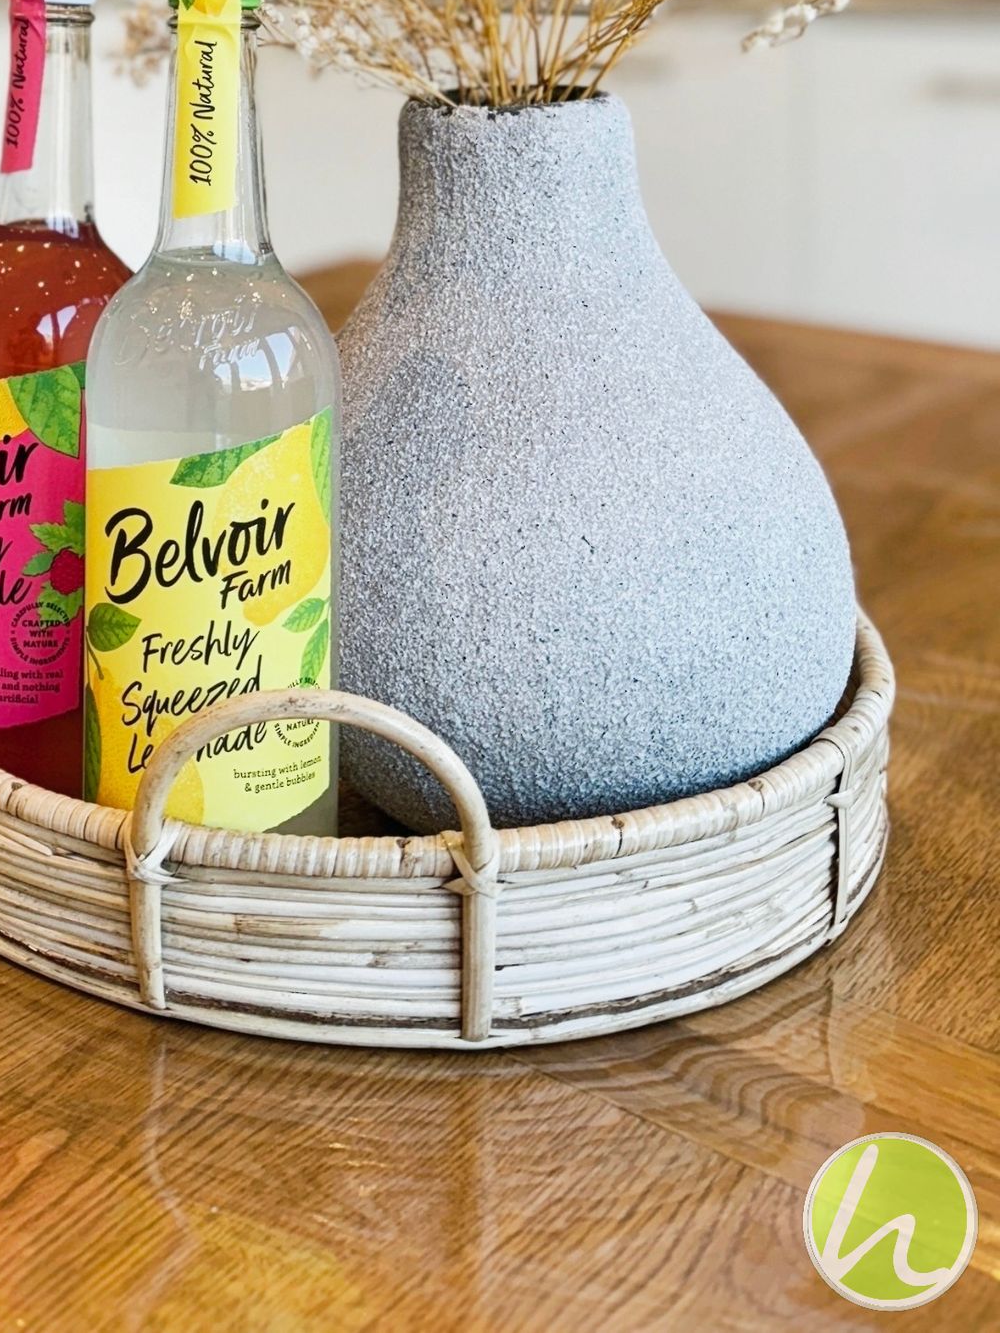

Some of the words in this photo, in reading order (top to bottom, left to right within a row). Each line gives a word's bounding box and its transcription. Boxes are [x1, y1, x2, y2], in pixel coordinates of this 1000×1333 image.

[12, 15, 30, 89] Natural
[189, 40, 218, 120] Natural
[4, 92, 25, 148] 100%
[189, 123, 217, 186] 100%
[105, 498, 295, 604] Belvoir
[220, 560, 291, 609] Farm
[22, 619, 61, 627] CRAFTED
[23, 640, 58, 648] NATURE
[29, 629, 54, 637] WITH
[142, 620, 260, 673] Freshly
[1, 681, 20, 691] and
[22, 681, 60, 693] nothing
[21, 669, 43, 679] with
[45, 669, 64, 679] real
[121, 654, 262, 737] Squeezed
[128, 721, 268, 774] Lenade
[274, 722, 292, 746] SIMPLE
[233, 769, 277, 779] bursting
[279, 762, 299, 774] with
[300, 755, 322, 769] lemon
[244, 783, 252, 792] &
[255, 778, 284, 793] gentle
[286, 771, 316, 786] bubbles
